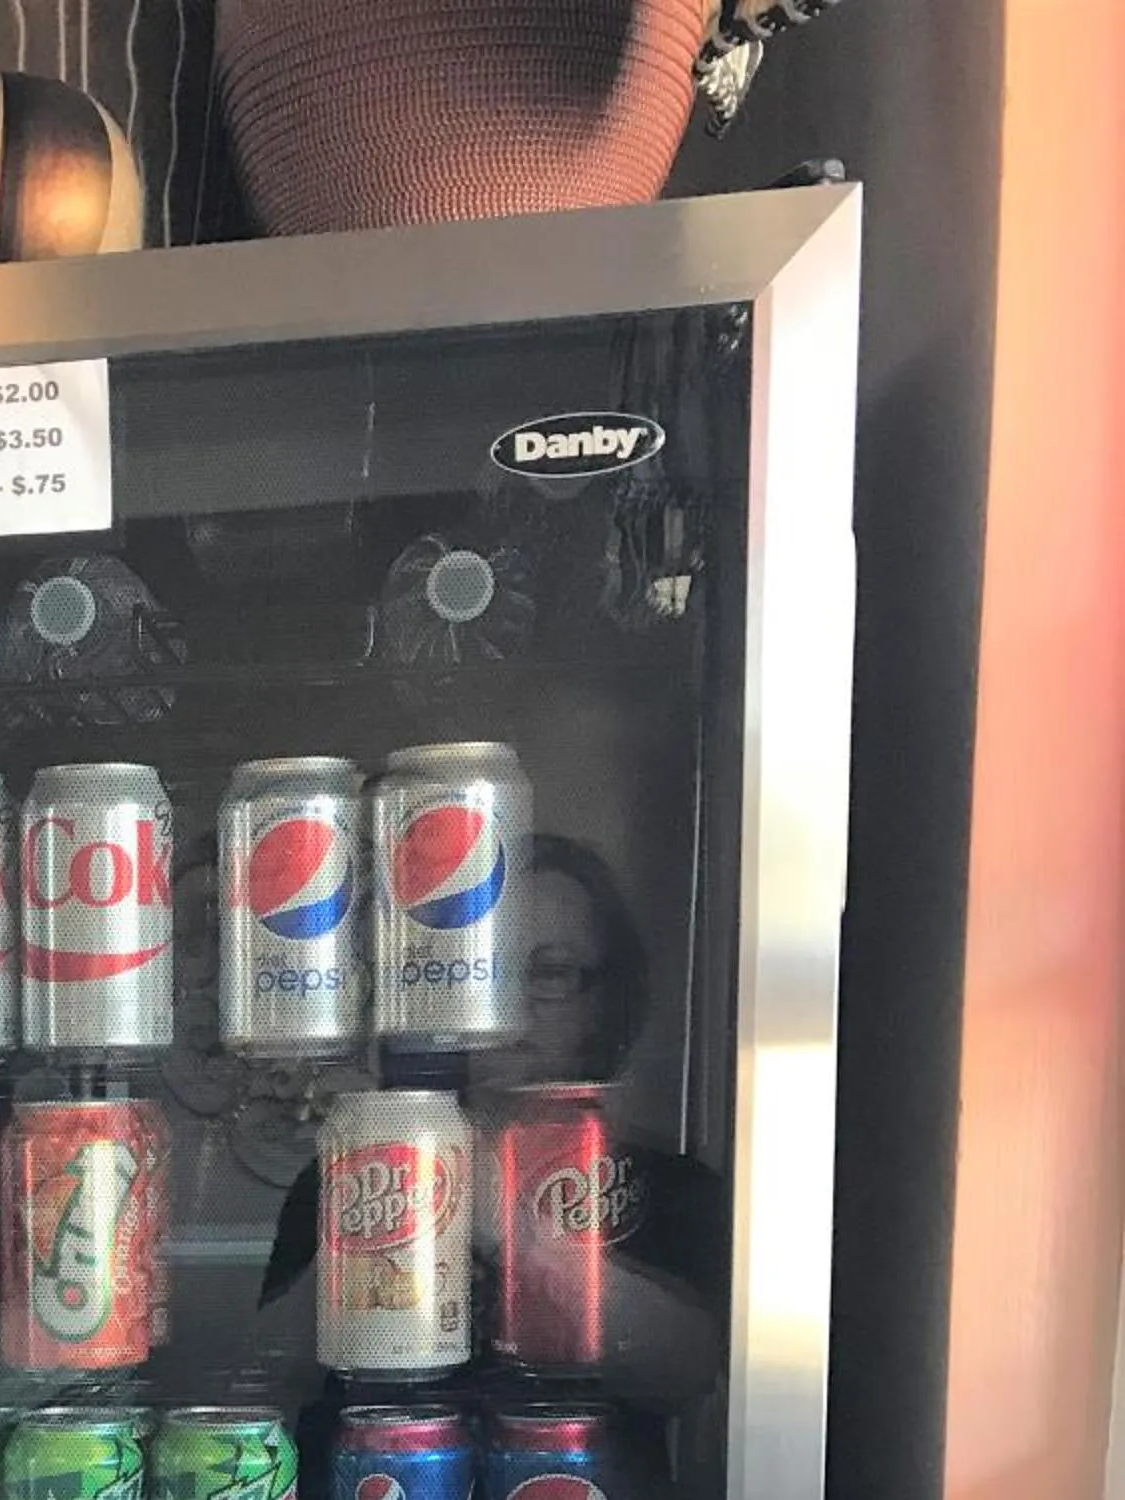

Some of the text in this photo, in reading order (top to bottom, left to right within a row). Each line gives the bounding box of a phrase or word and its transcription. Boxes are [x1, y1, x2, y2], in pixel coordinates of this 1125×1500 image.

[515, 426, 648, 462] Danby
[12, 474, 66, 496] $.75
[361, 1160, 411, 1201] Dr
[589, 1155, 633, 1197] Dr
[533, 1167, 639, 1240] Pepp
